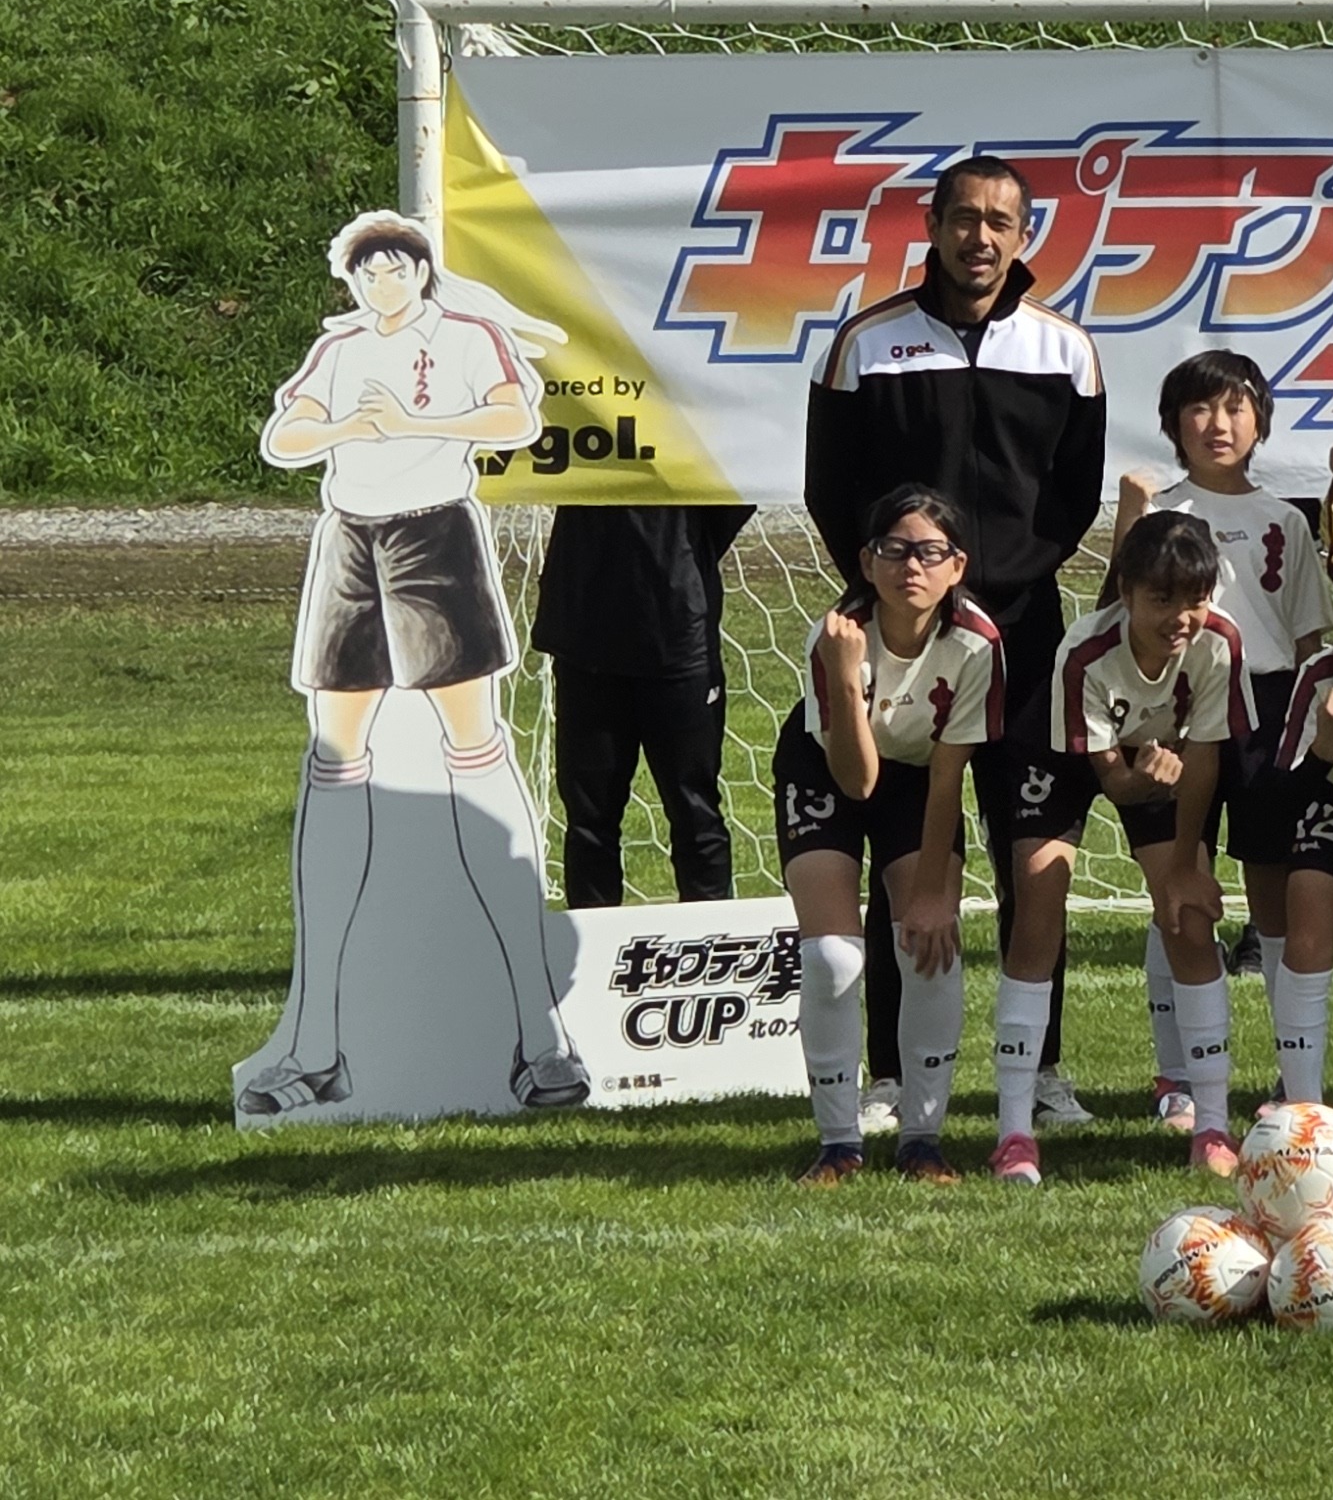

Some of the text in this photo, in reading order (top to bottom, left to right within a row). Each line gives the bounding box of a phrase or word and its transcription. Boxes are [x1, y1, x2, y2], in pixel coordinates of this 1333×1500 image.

[412, 347, 436, 411] ふらの
[612, 377, 645, 398] by
[621, 993, 750, 1051] CUP
[995, 1040, 1032, 1057] ol.
